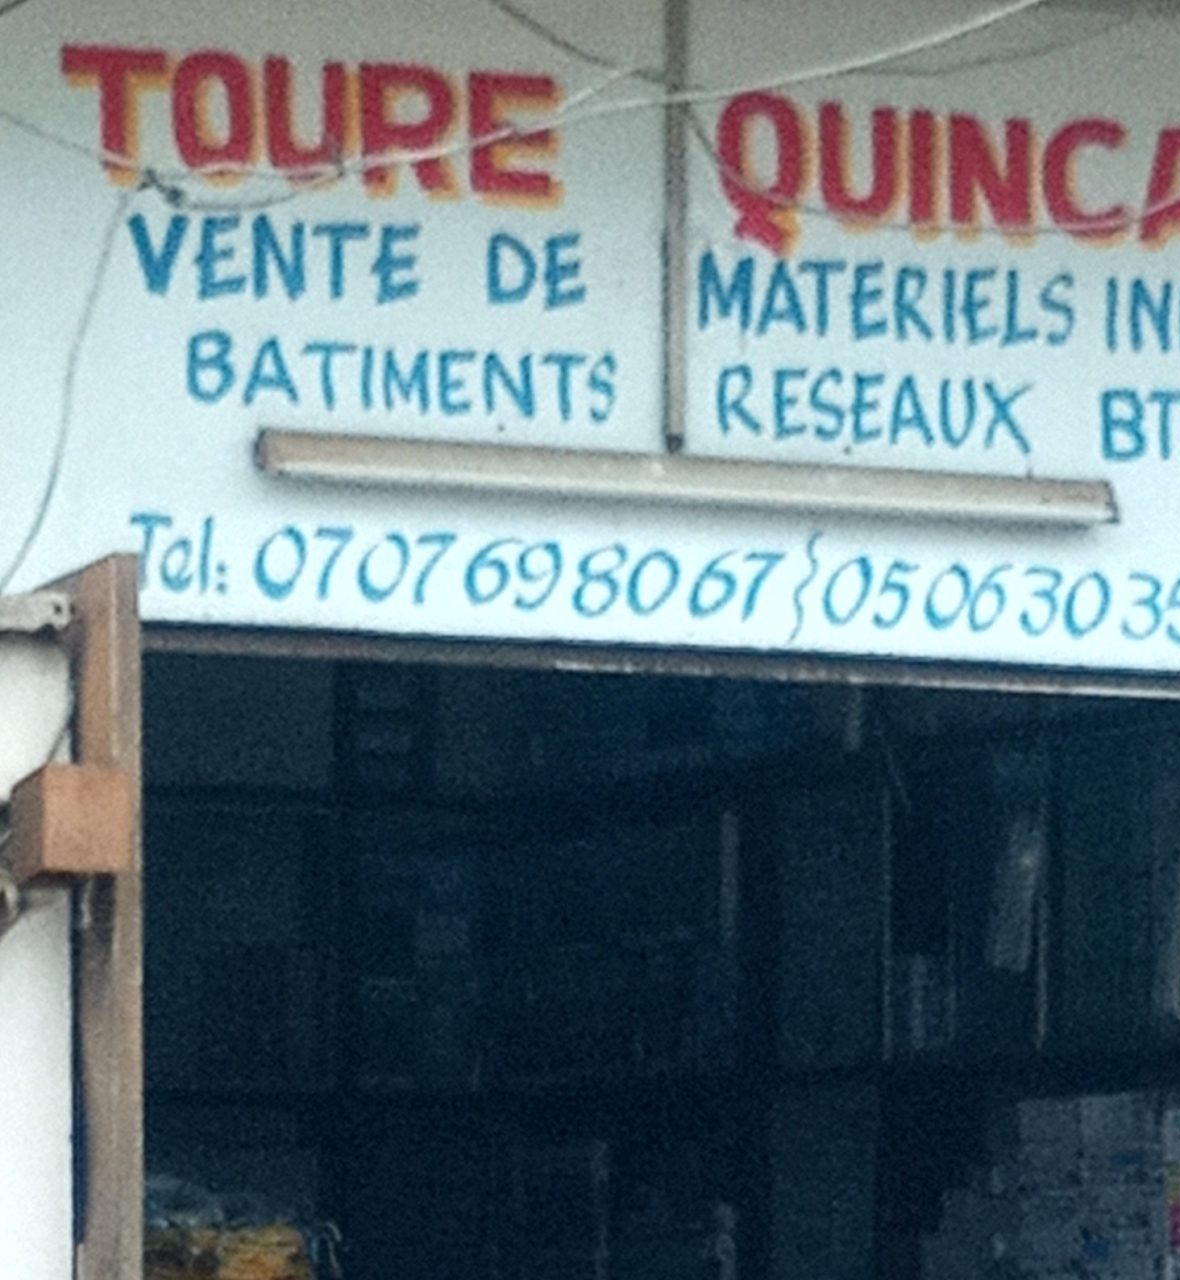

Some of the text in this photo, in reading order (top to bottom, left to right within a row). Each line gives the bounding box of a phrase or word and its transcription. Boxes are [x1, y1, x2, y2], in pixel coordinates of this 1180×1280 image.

[61, 43, 563, 210] TOURE
[128, 213, 421, 306] VENTE
[486, 232, 587, 311] DE
[697, 251, 1076, 348] MATERIELS
[185, 329, 618, 424] BATIMENTS
[715, 364, 1031, 456] RESEAUX
[130, 511, 228, 594] Tel:
[253, 524, 785, 619] 0707698067
